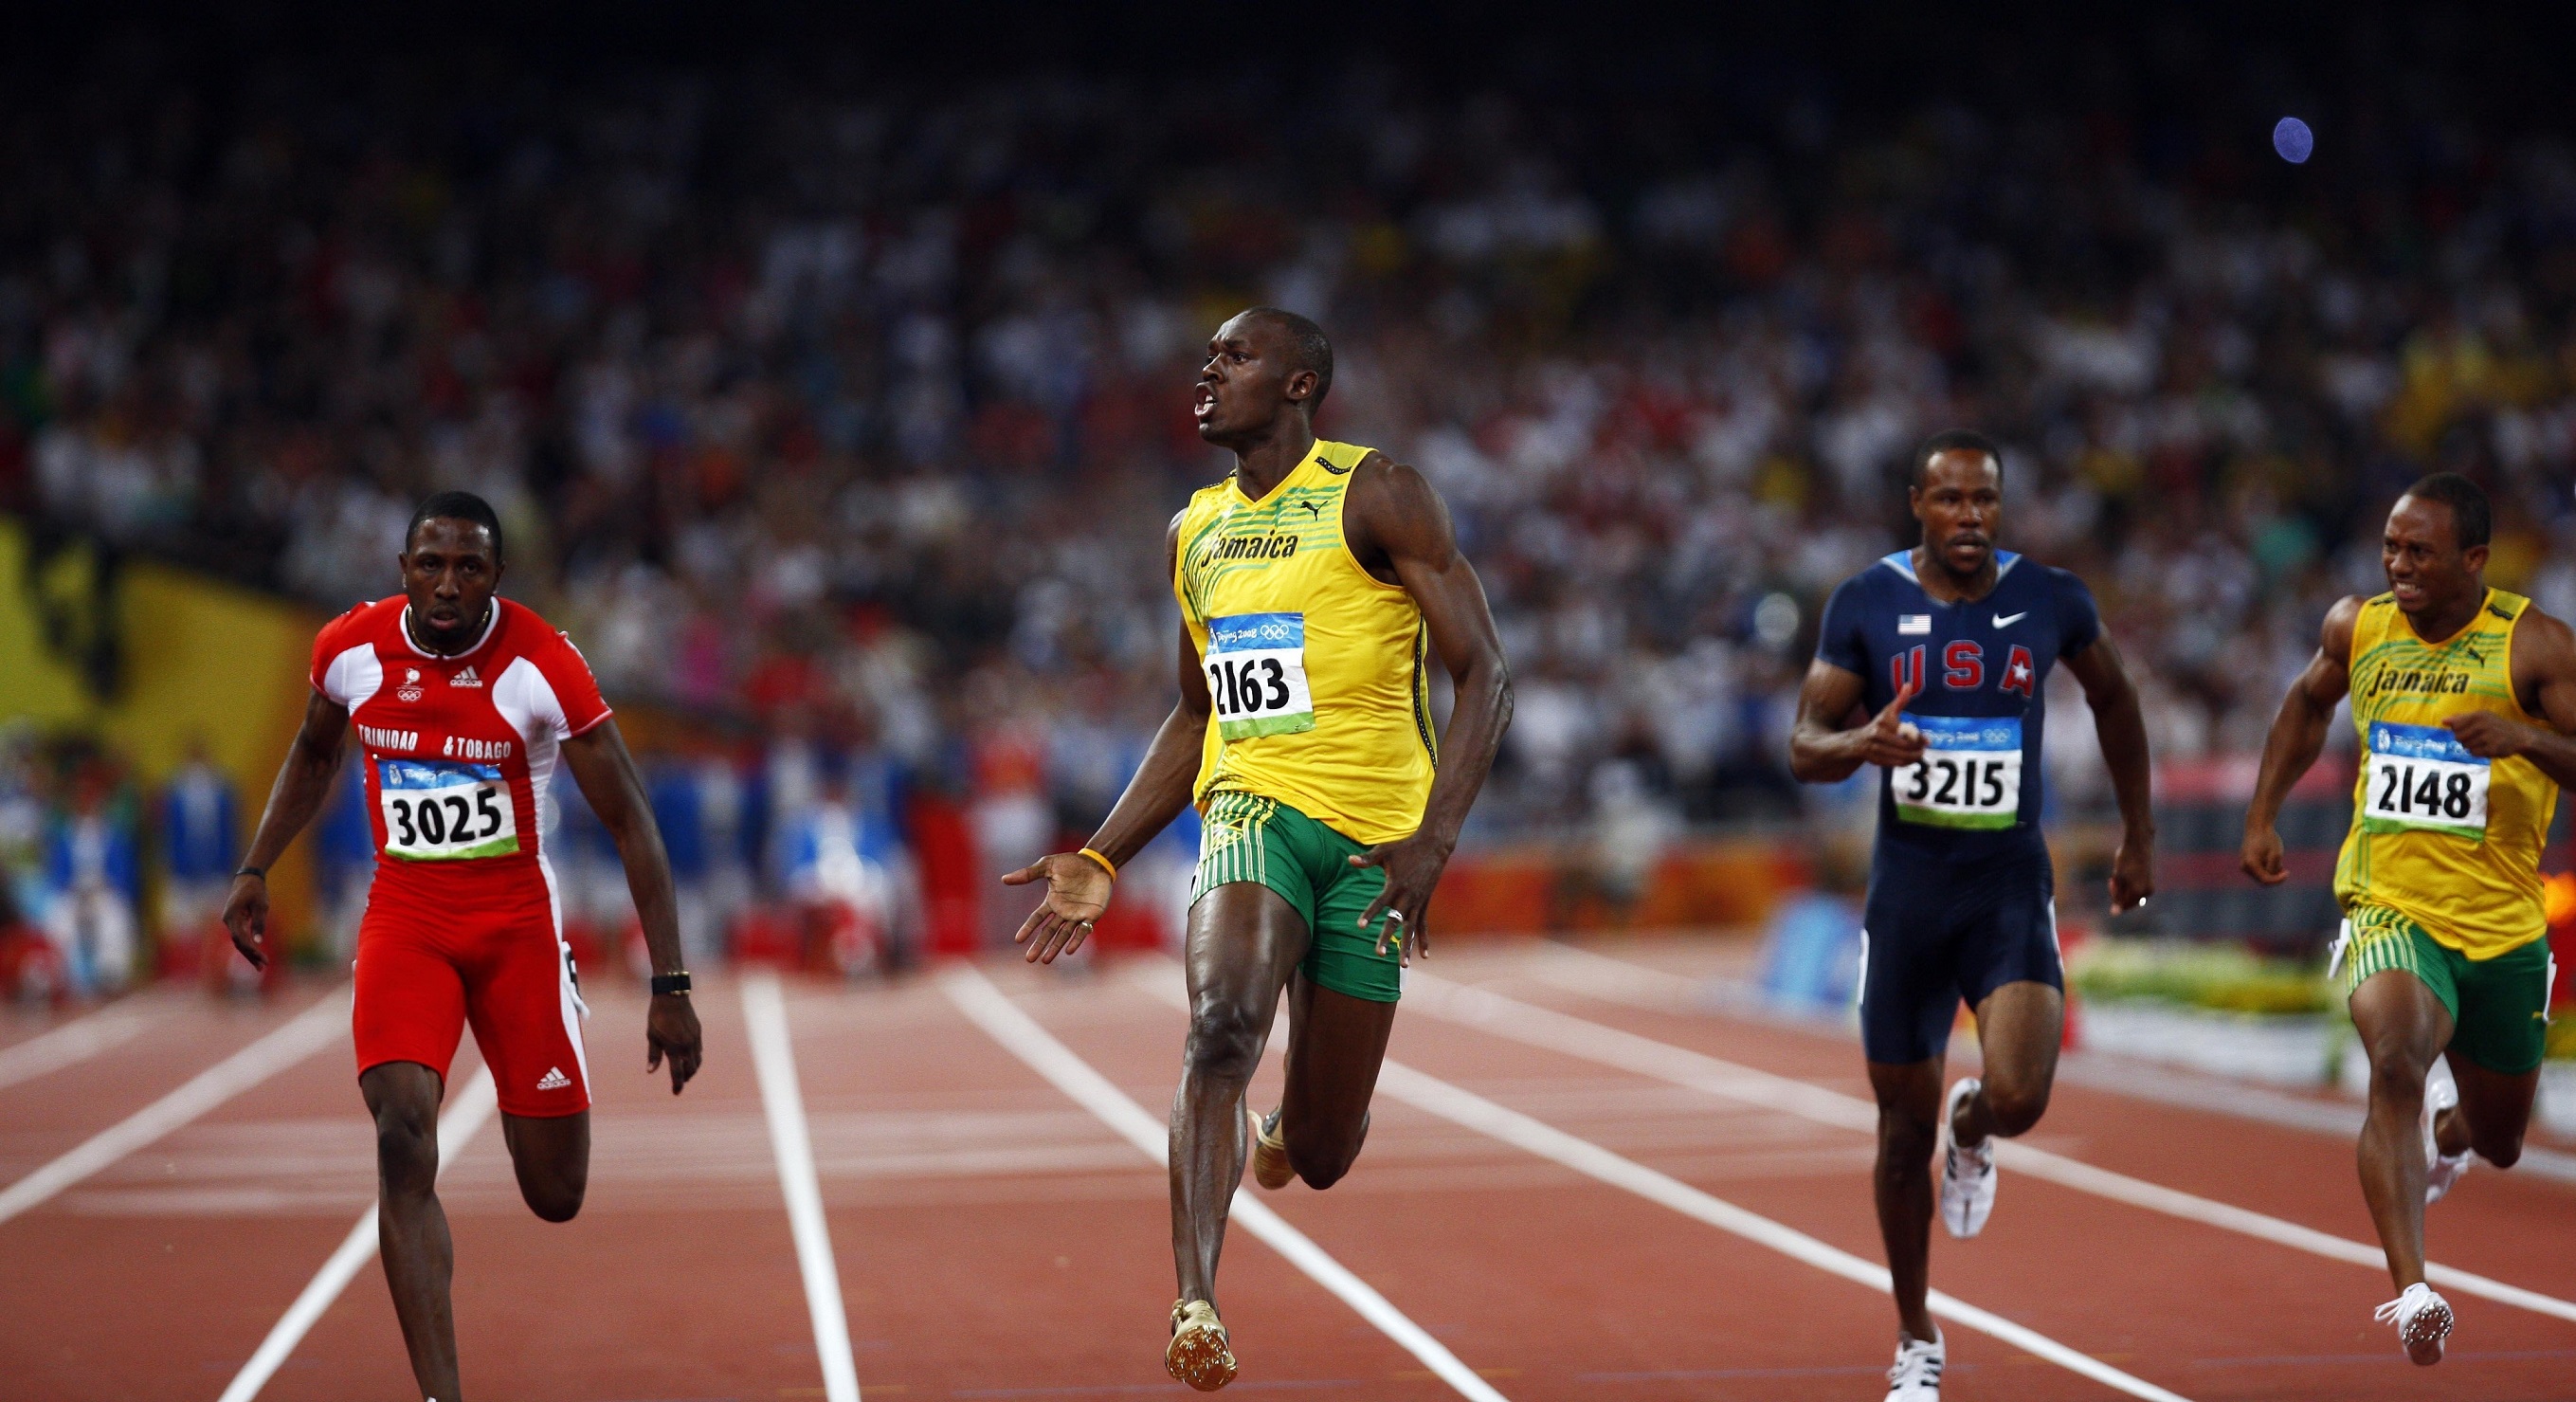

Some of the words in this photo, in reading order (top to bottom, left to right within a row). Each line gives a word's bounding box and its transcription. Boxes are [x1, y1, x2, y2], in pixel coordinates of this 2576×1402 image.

[1201, 530, 1298, 568] jamaica
[1238, 628, 1258, 639] 2008
[450, 679, 483, 687] adidas
[1209, 658, 1290, 715] 2163
[2368, 663, 2470, 697] jamaica
[357, 723, 419, 752] TRINIDAD
[443, 736, 455, 756] &
[457, 737, 512, 759] TOBAGO
[1907, 760, 2004, 807] 3215
[2378, 764, 2472, 819] 2148
[392, 788, 502, 847] 3025
[536, 1079, 571, 1090] adidas
